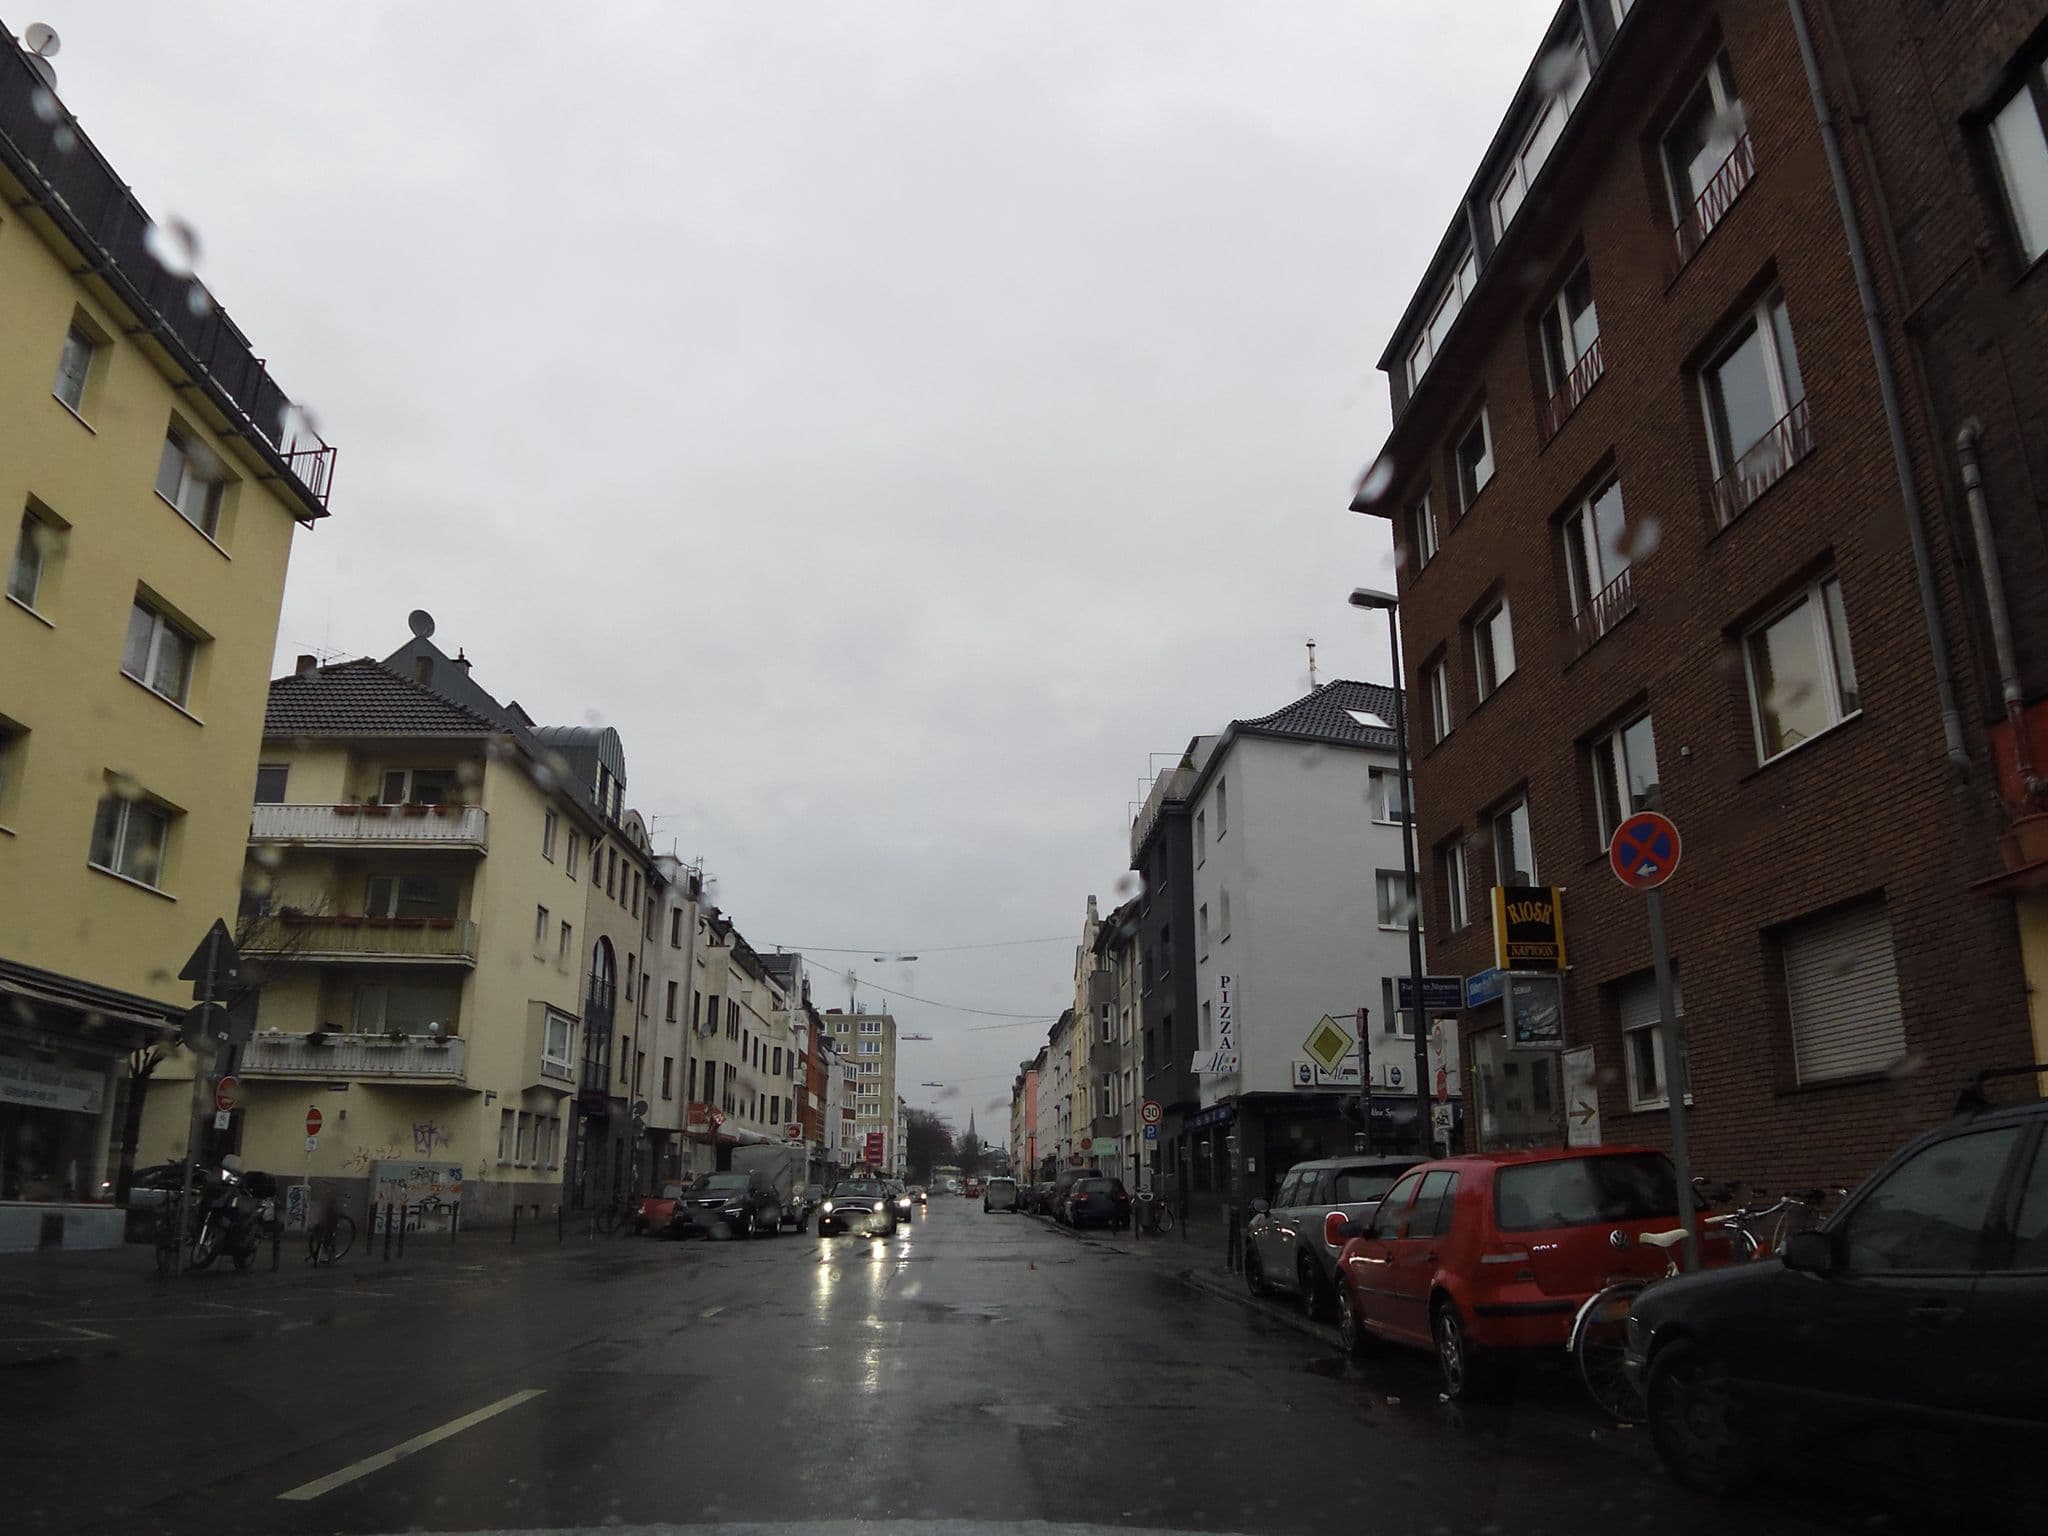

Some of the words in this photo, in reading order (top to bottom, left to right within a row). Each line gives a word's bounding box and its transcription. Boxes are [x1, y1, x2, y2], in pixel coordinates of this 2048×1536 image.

[1507, 901, 1552, 924] KIOSK
[1220, 976, 1231, 1049] PIZZA
[1194, 1052, 1233, 1072] Alex
[1146, 1107, 1158, 1118] 30
[1147, 1126, 1156, 1138] P
